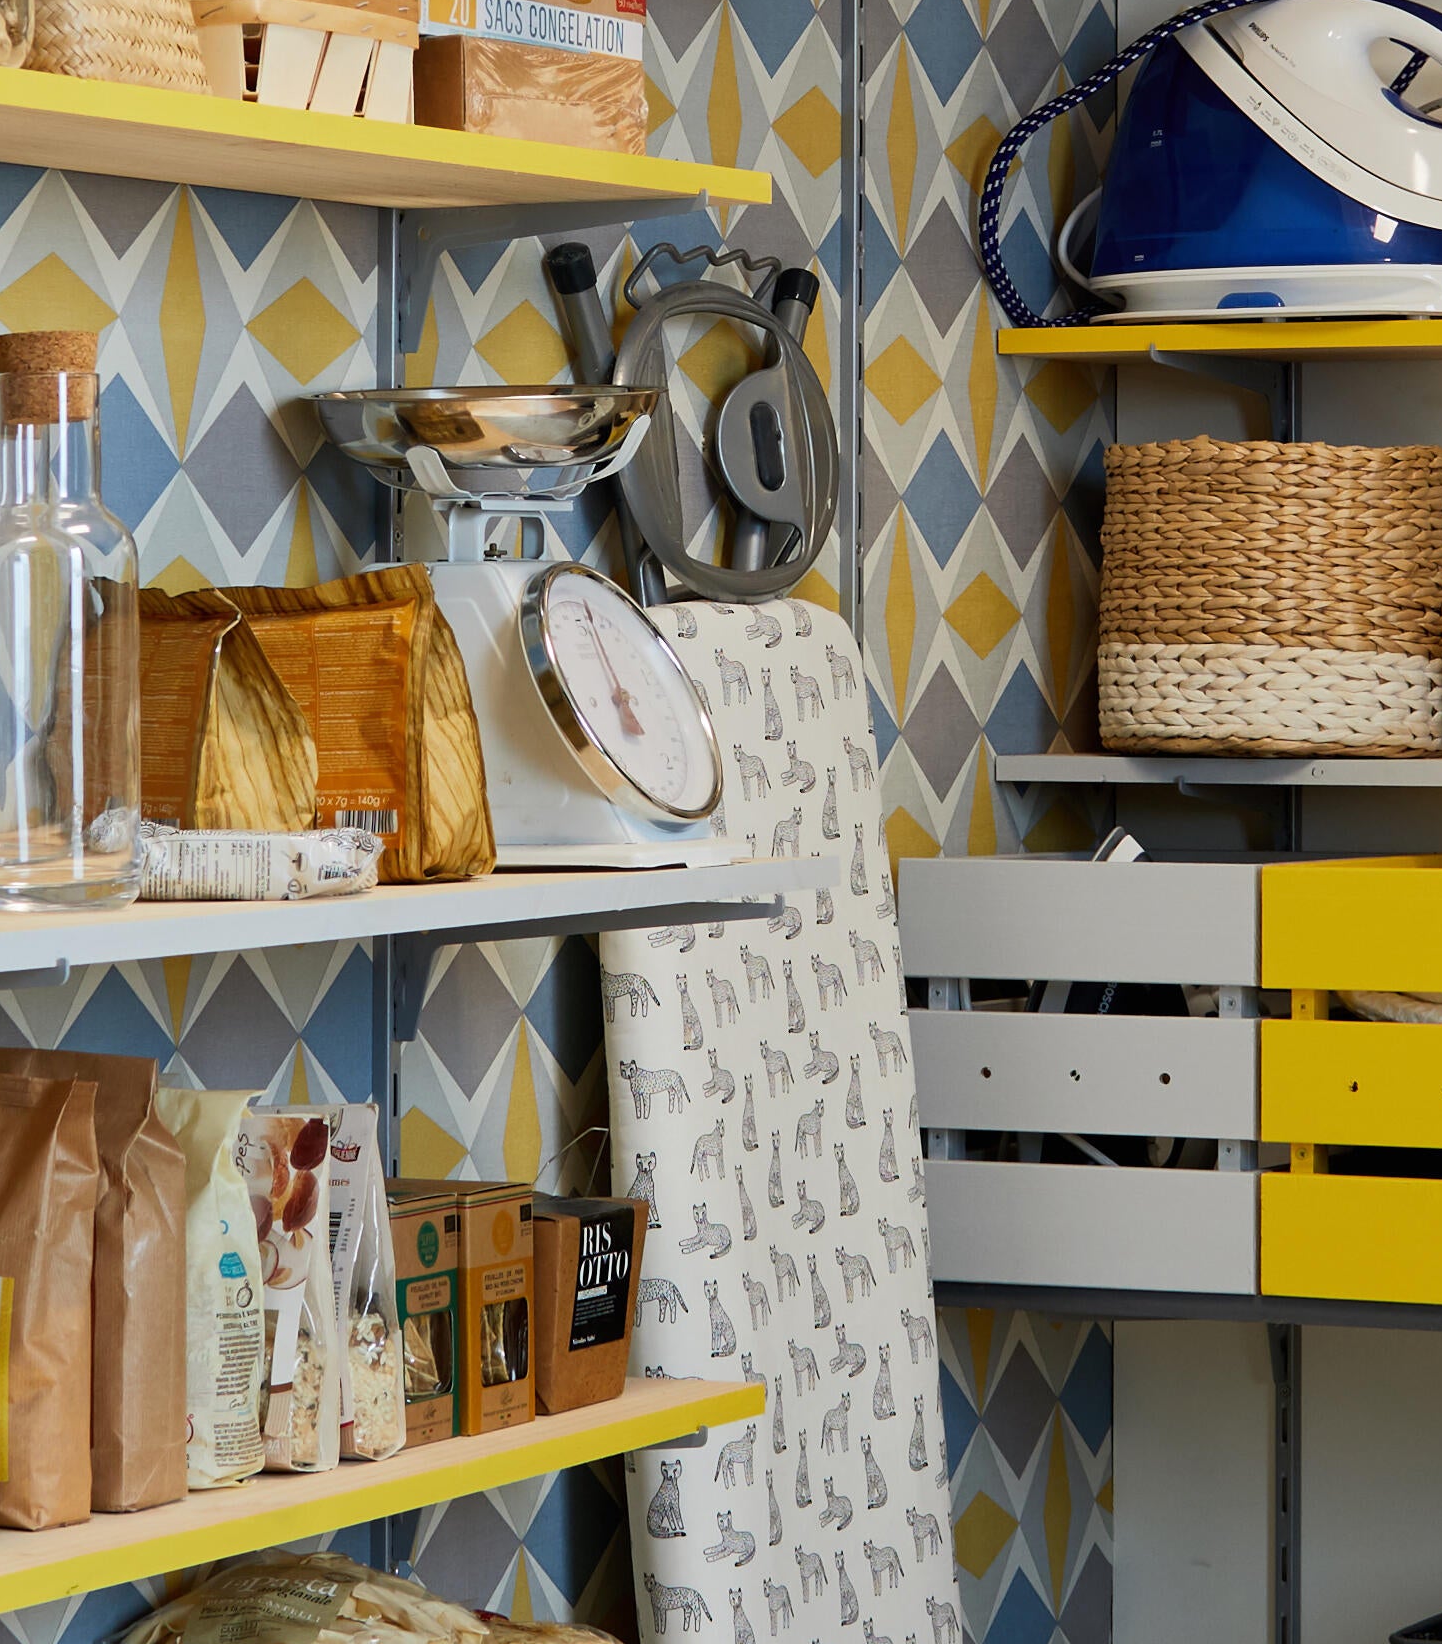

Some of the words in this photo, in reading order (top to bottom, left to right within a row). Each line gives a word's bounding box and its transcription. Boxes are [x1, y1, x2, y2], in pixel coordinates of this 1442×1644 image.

[528, 4, 625, 55] CONGELATION
[1248, 21, 1270, 43] PHILIPS
[334, 796, 349, 808] 7g
[356, 795, 381, 808] 140g
[582, 1221, 613, 1257] RIS
[579, 1248, 630, 1288] OTTO
